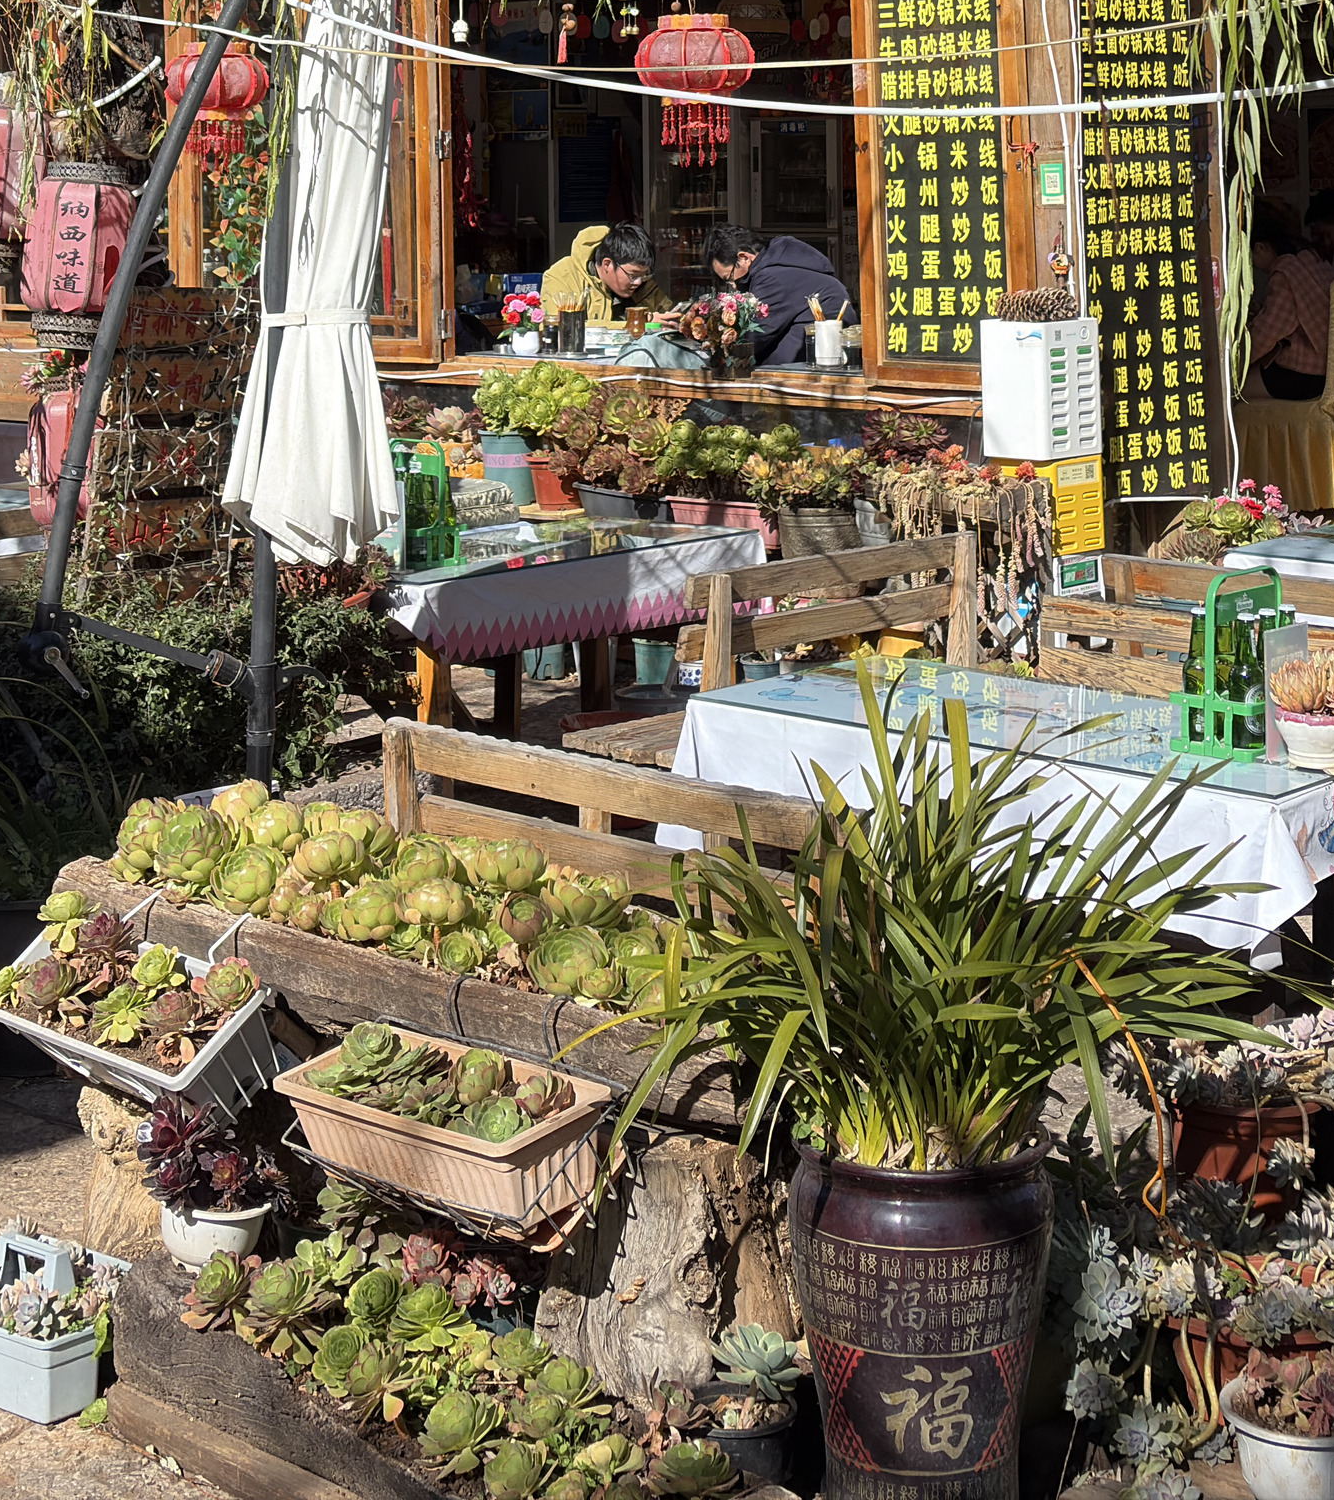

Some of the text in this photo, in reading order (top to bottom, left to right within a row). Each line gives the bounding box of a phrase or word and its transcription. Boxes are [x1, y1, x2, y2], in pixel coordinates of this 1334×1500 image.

[879, 28, 992, 65] 牛肉砂锅米线
[1082, 28, 1188, 55] 野生菌砂锅米线 20元
[881, 64, 994, 100] 腊排骨砂锅米线
[1083, 61, 1167, 89] 三鲜砂锅米线
[779, 121, 807, 133] 消毒柜
[883, 102, 995, 136] 火腿砂锅米线
[884, 138, 997, 172] 小锅米线
[1175, 128, 1191, 153] 25元
[1177, 161, 1193, 185] 25元
[886, 175, 999, 208] 扬州炒饭
[1177, 193, 1194, 218] 20元
[887, 212, 1001, 244] 火腿炒饭
[1179, 226, 1195, 251] 18元
[53, 200, 90, 294] 纳西味道
[887, 249, 1003, 280] 鸡蛋炒饭
[1088, 260, 1175, 294] 小锅米线
[1181, 259, 1198, 284] 18元
[889, 286, 1004, 316] 火腿蛋炒饭
[1088, 292, 1200, 325] 炒米线 18元
[1184, 325, 1202, 351] 20元
[1113, 358, 1203, 394] 腿炒饭 25元
[1113, 392, 1205, 428] 蛋炒饭 15元
[1108, 425, 1207, 463] 腿蛋炒饭 28元
[1115, 461, 1186, 496] 西炒饭
[1191, 458, 1210, 484] 20元
[880, 1365, 974, 1460] 福
